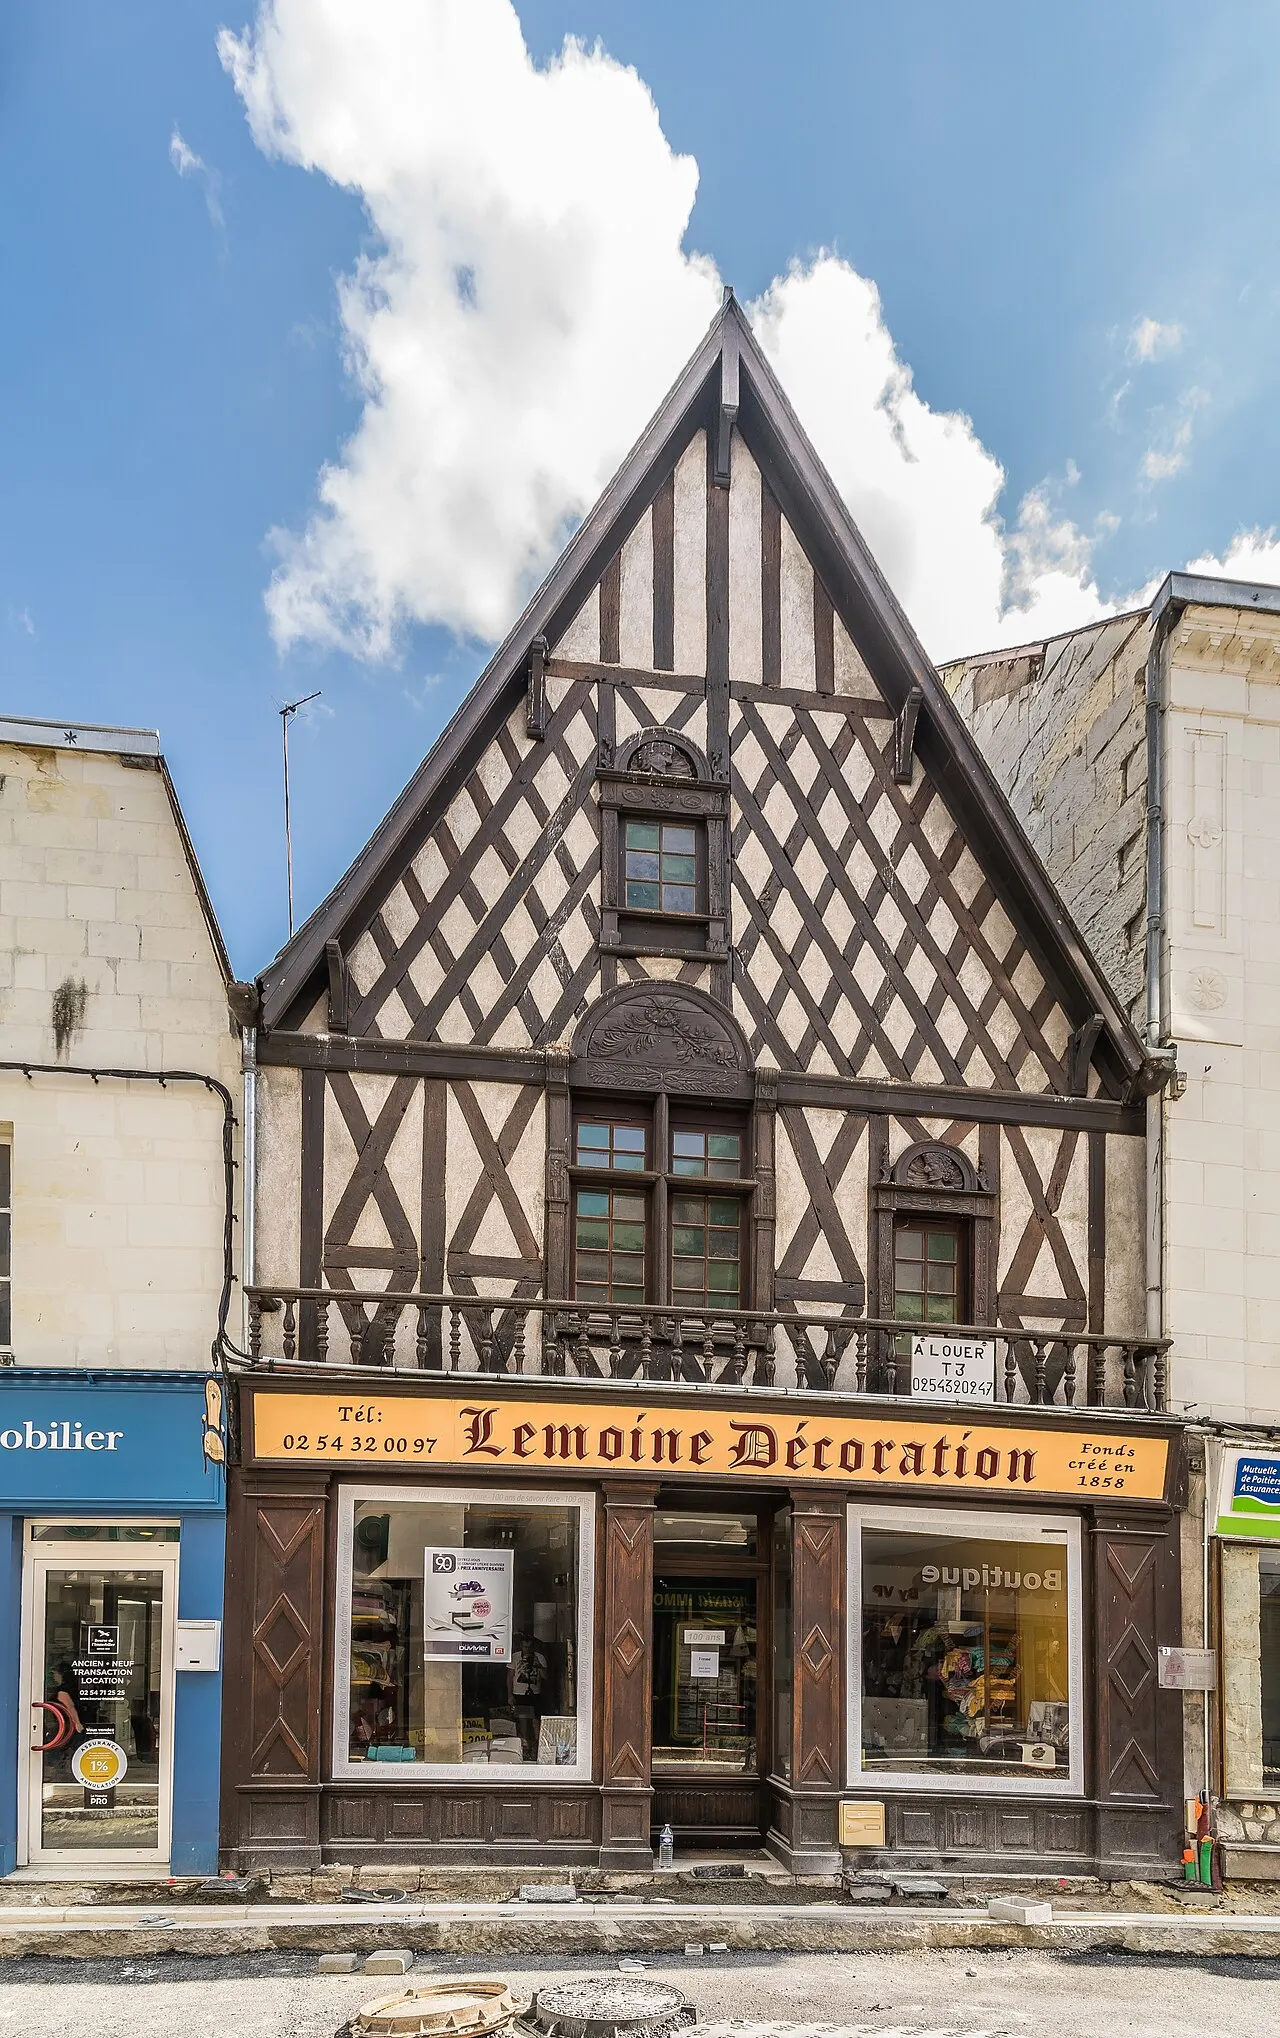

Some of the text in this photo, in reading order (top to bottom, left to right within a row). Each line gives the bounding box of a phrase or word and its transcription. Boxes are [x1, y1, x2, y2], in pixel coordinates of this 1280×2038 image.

[914, 1343, 984, 1359] A LOUER
[912, 1377, 993, 1396] 0254320247
[338, 1405, 383, 1423] Tél:
[0, 1421, 124, 1450] obilier
[283, 1434, 438, 1454] 02 54 32 00 97
[459, 1406, 1039, 1484] Lemoine Décoration
[1080, 1443, 1135, 1457] Fonds
[1068, 1458, 1136, 1473] créé en
[1242, 1464, 1278, 1475] Mutuelle
[1077, 1475, 1125, 1489] 1858
[1241, 1474, 1251, 1483] de
[492, 1493, 503, 1501] 100
[516, 1494, 525, 1502] de
[545, 1494, 560, 1504] faire
[565, 1495, 577, 1503] 100
[583, 1541, 591, 1549] de
[342, 1547, 350, 1566] savoir
[582, 1549, 590, 1568] savoir
[435, 1556, 452, 1571] 90
[341, 1566, 349, 1575] de
[582, 1568, 591, 1582] faire
[341, 1587, 349, 1599] 100
[582, 1587, 590, 1598] 100
[339, 1604, 349, 1618] faire
[581, 1611, 589, 1619] de
[340, 1618, 348, 1638] savoir
[581, 1620, 589, 1637] savoir
[850, 1623, 858, 1634] 100
[339, 1639, 348, 1647] de
[688, 1633, 721, 1641] 100 ans
[581, 1639, 590, 1652] faire
[850, 1639, 859, 1652] faire
[339, 1659, 347, 1670] 100
[581, 1658, 589, 1669] 100
[850, 1672, 859, 1680] de
[1071, 1678, 1080, 1686] de
[338, 1676, 347, 1690] faire
[339, 1691, 347, 1710] savoir
[850, 1691, 858, 1703] 100
[338, 1711, 346, 1719] de
[580, 1710, 589, 1724] faire
[1071, 1704, 1080, 1719] faire
[1072, 1723, 1080, 1734] 100
[338, 1731, 346, 1742] 100
[80, 1741, 120, 1752] ASSURANCE
[90, 1760, 108, 1772] 1%
[391, 1767, 402, 1776] 100
[466, 1768, 478, 1776] 100
[80, 1777, 120, 1789] ANNULATION
[966, 1779, 977, 1788] 100
[1033, 1782, 1044, 1790] 100
[90, 1797, 107, 1805] PRO
